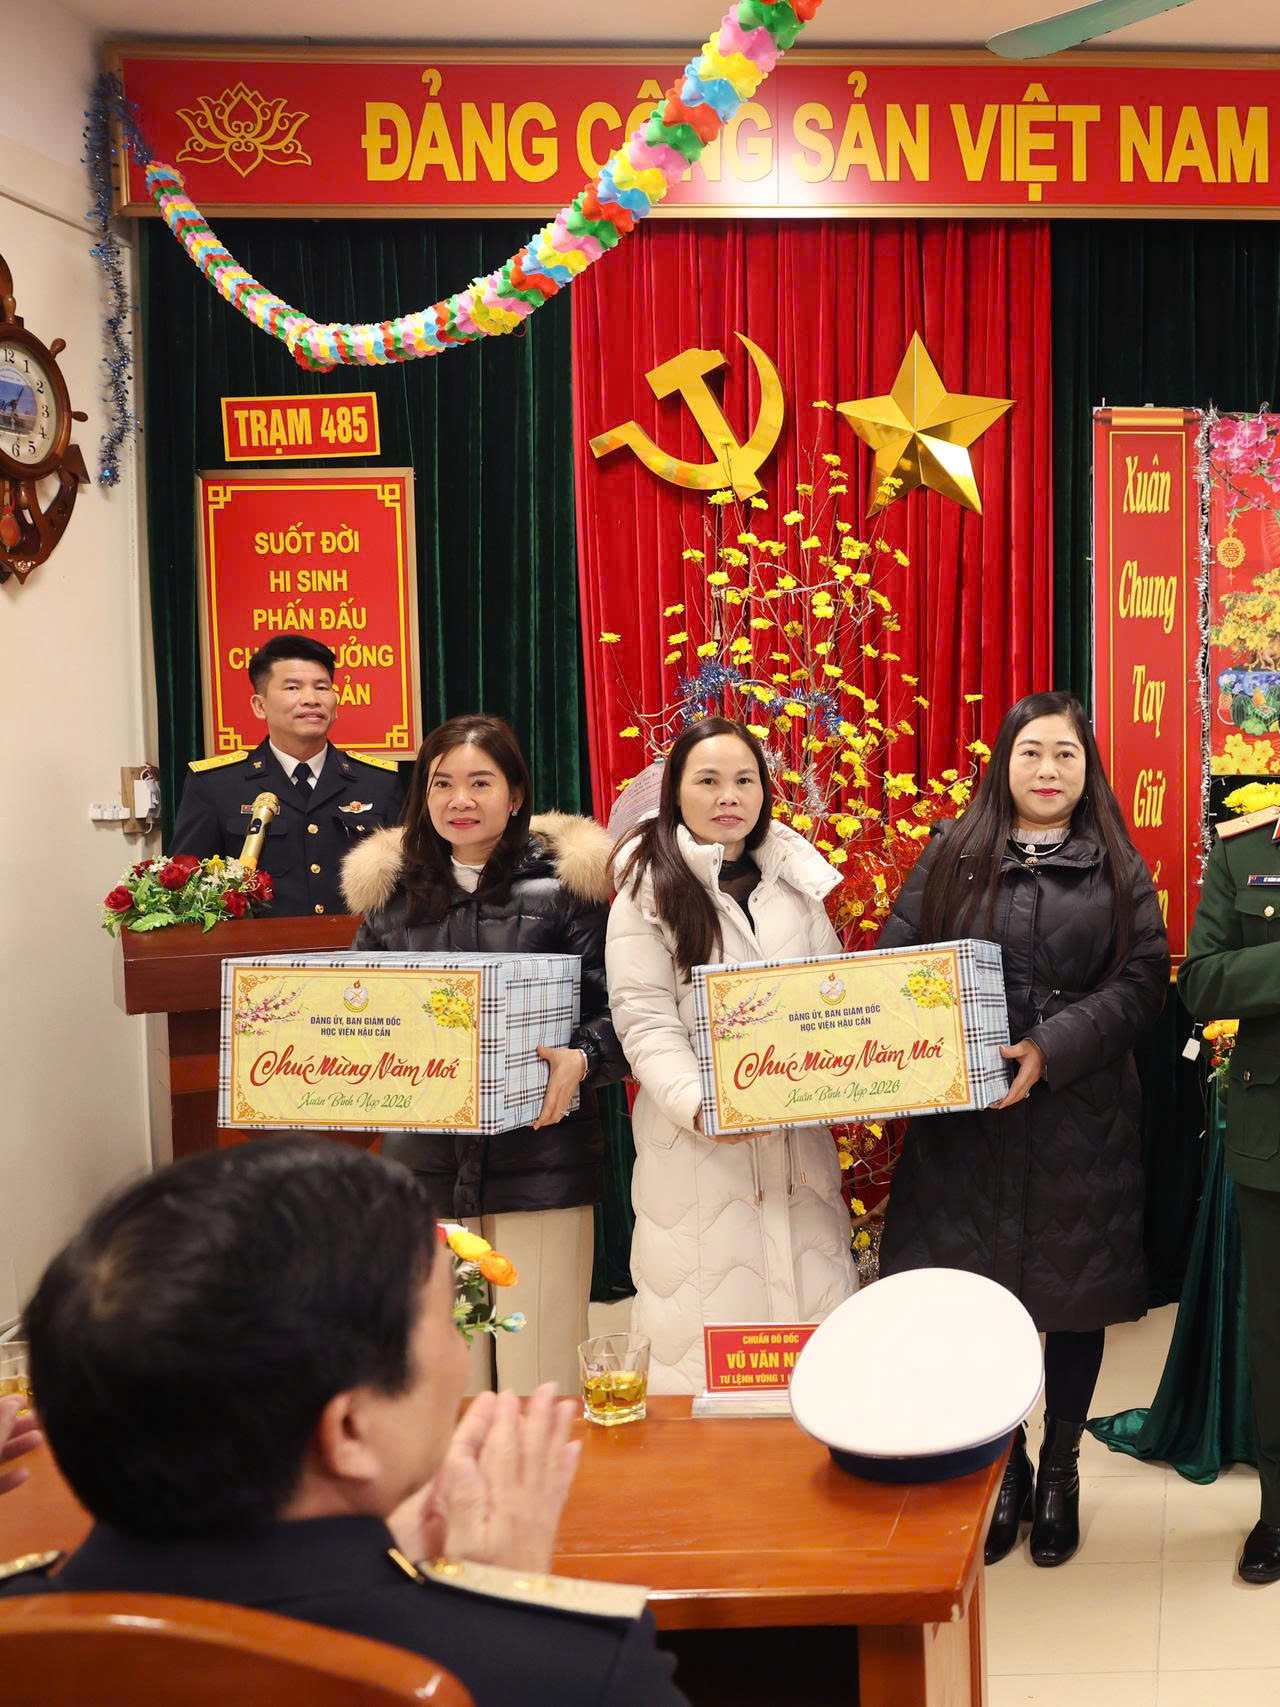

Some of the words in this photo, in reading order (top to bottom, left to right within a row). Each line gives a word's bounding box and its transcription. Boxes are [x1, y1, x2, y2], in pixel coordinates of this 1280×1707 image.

[361, 68, 559, 184] ĐẢNG
[792, 70, 930, 183] SẢN
[951, 83, 1101, 202] VIỆT
[1119, 105, 1269, 184] NAM
[3, 348, 15, 364] 12
[24, 360, 30, 373] 1
[36, 380, 44, 394] 2
[41, 405, 50, 418] 3
[39, 426, 48, 440] 4
[234, 406, 312, 455] TRẠM
[321, 406, 369, 445] 485
[12, 437, 20, 457] 6
[28, 441, 36, 454] 5
[1122, 453, 1171, 514] Xuân
[254, 521, 315, 555] SUỐT
[320, 522, 361, 554] ĐỜI
[269, 571, 291, 592] HI
[296, 570, 348, 593] SINH
[1118, 559, 1177, 634] Chung
[252, 599, 314, 632] PHẤN
[319, 598, 367, 631] ĐẤU
[1131, 664, 1168, 738] Tay
[1132, 769, 1168, 829] Giữ
[346, 1016, 362, 1025] BAN
[825, 1009, 841, 1018] BAN
[321, 1027, 336, 1037] HỌC
[800, 1023, 816, 1033] HỌC
[250, 1044, 321, 1087] Chúc
[315, 1054, 372, 1085] Mừng
[370, 1052, 425, 1087] Năm
[422, 1058, 460, 1080] Mới
[733, 1043, 807, 1090] Chúc
[799, 1049, 856, 1077] Mừng
[855, 1039, 911, 1070] Năm
[909, 1037, 944, 1060] Mới
[868, 1079, 901, 1095] 2026
[381, 1095, 413, 1109] 2026
[726, 1350, 746, 1369] VŨ
[749, 1349, 780, 1369] VĂN
